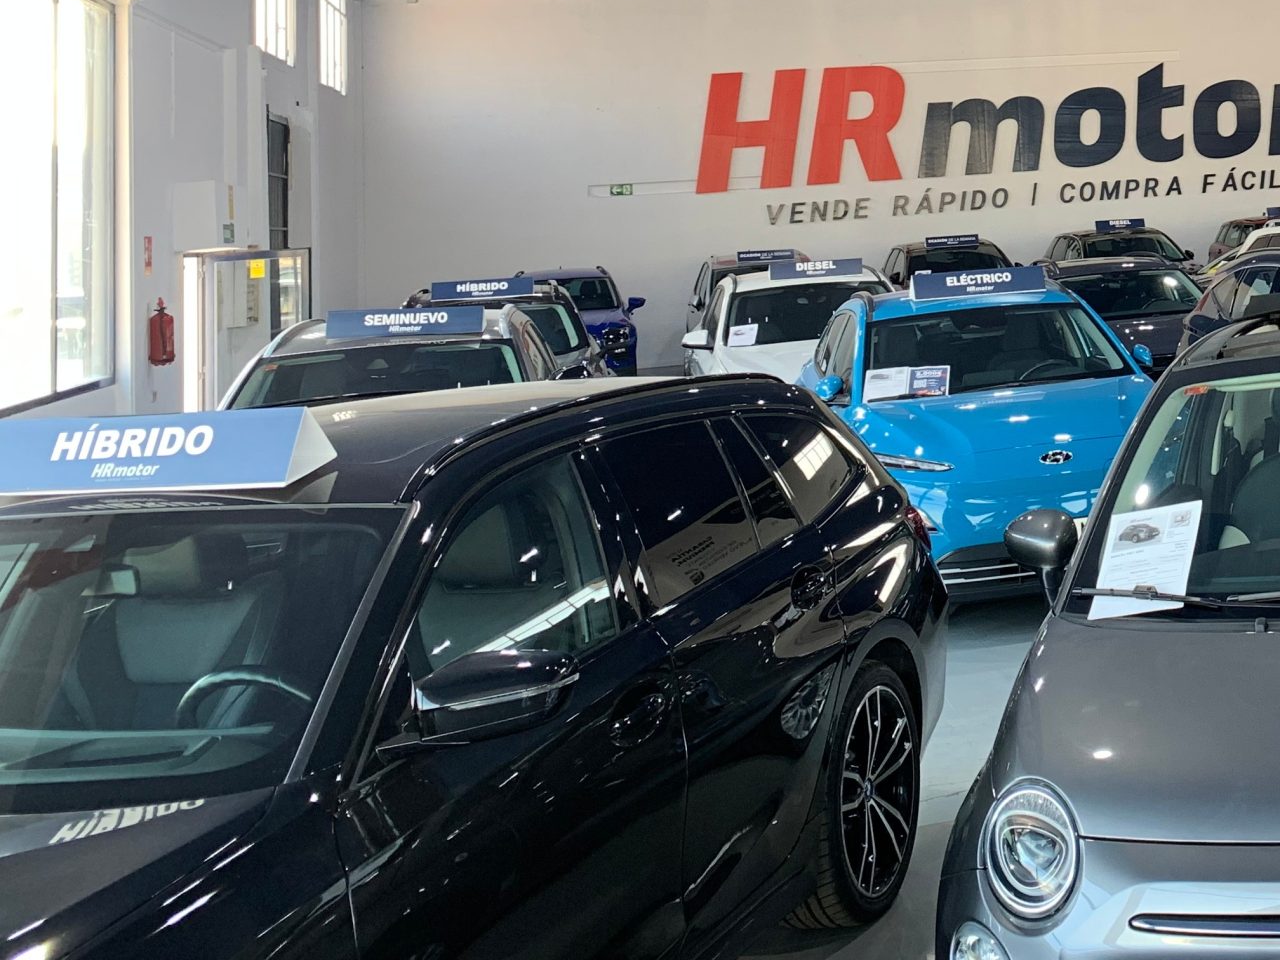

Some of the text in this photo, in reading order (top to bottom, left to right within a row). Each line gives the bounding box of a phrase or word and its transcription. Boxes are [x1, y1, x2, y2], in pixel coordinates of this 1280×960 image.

[766, 197, 871, 226] VENDE
[891, 187, 1010, 217] RÁPIDO
[1059, 176, 1183, 204] COMPRA
[796, 260, 836, 272] DIESEL
[456, 281, 509, 293] HÍBRIDO
[946, 271, 1012, 287] ELÉCTRICO
[364, 311, 448, 327] SEMINUEVO
[50, 424, 215, 462] HÍBRIDO
[90, 461, 160, 479] HRmotor
